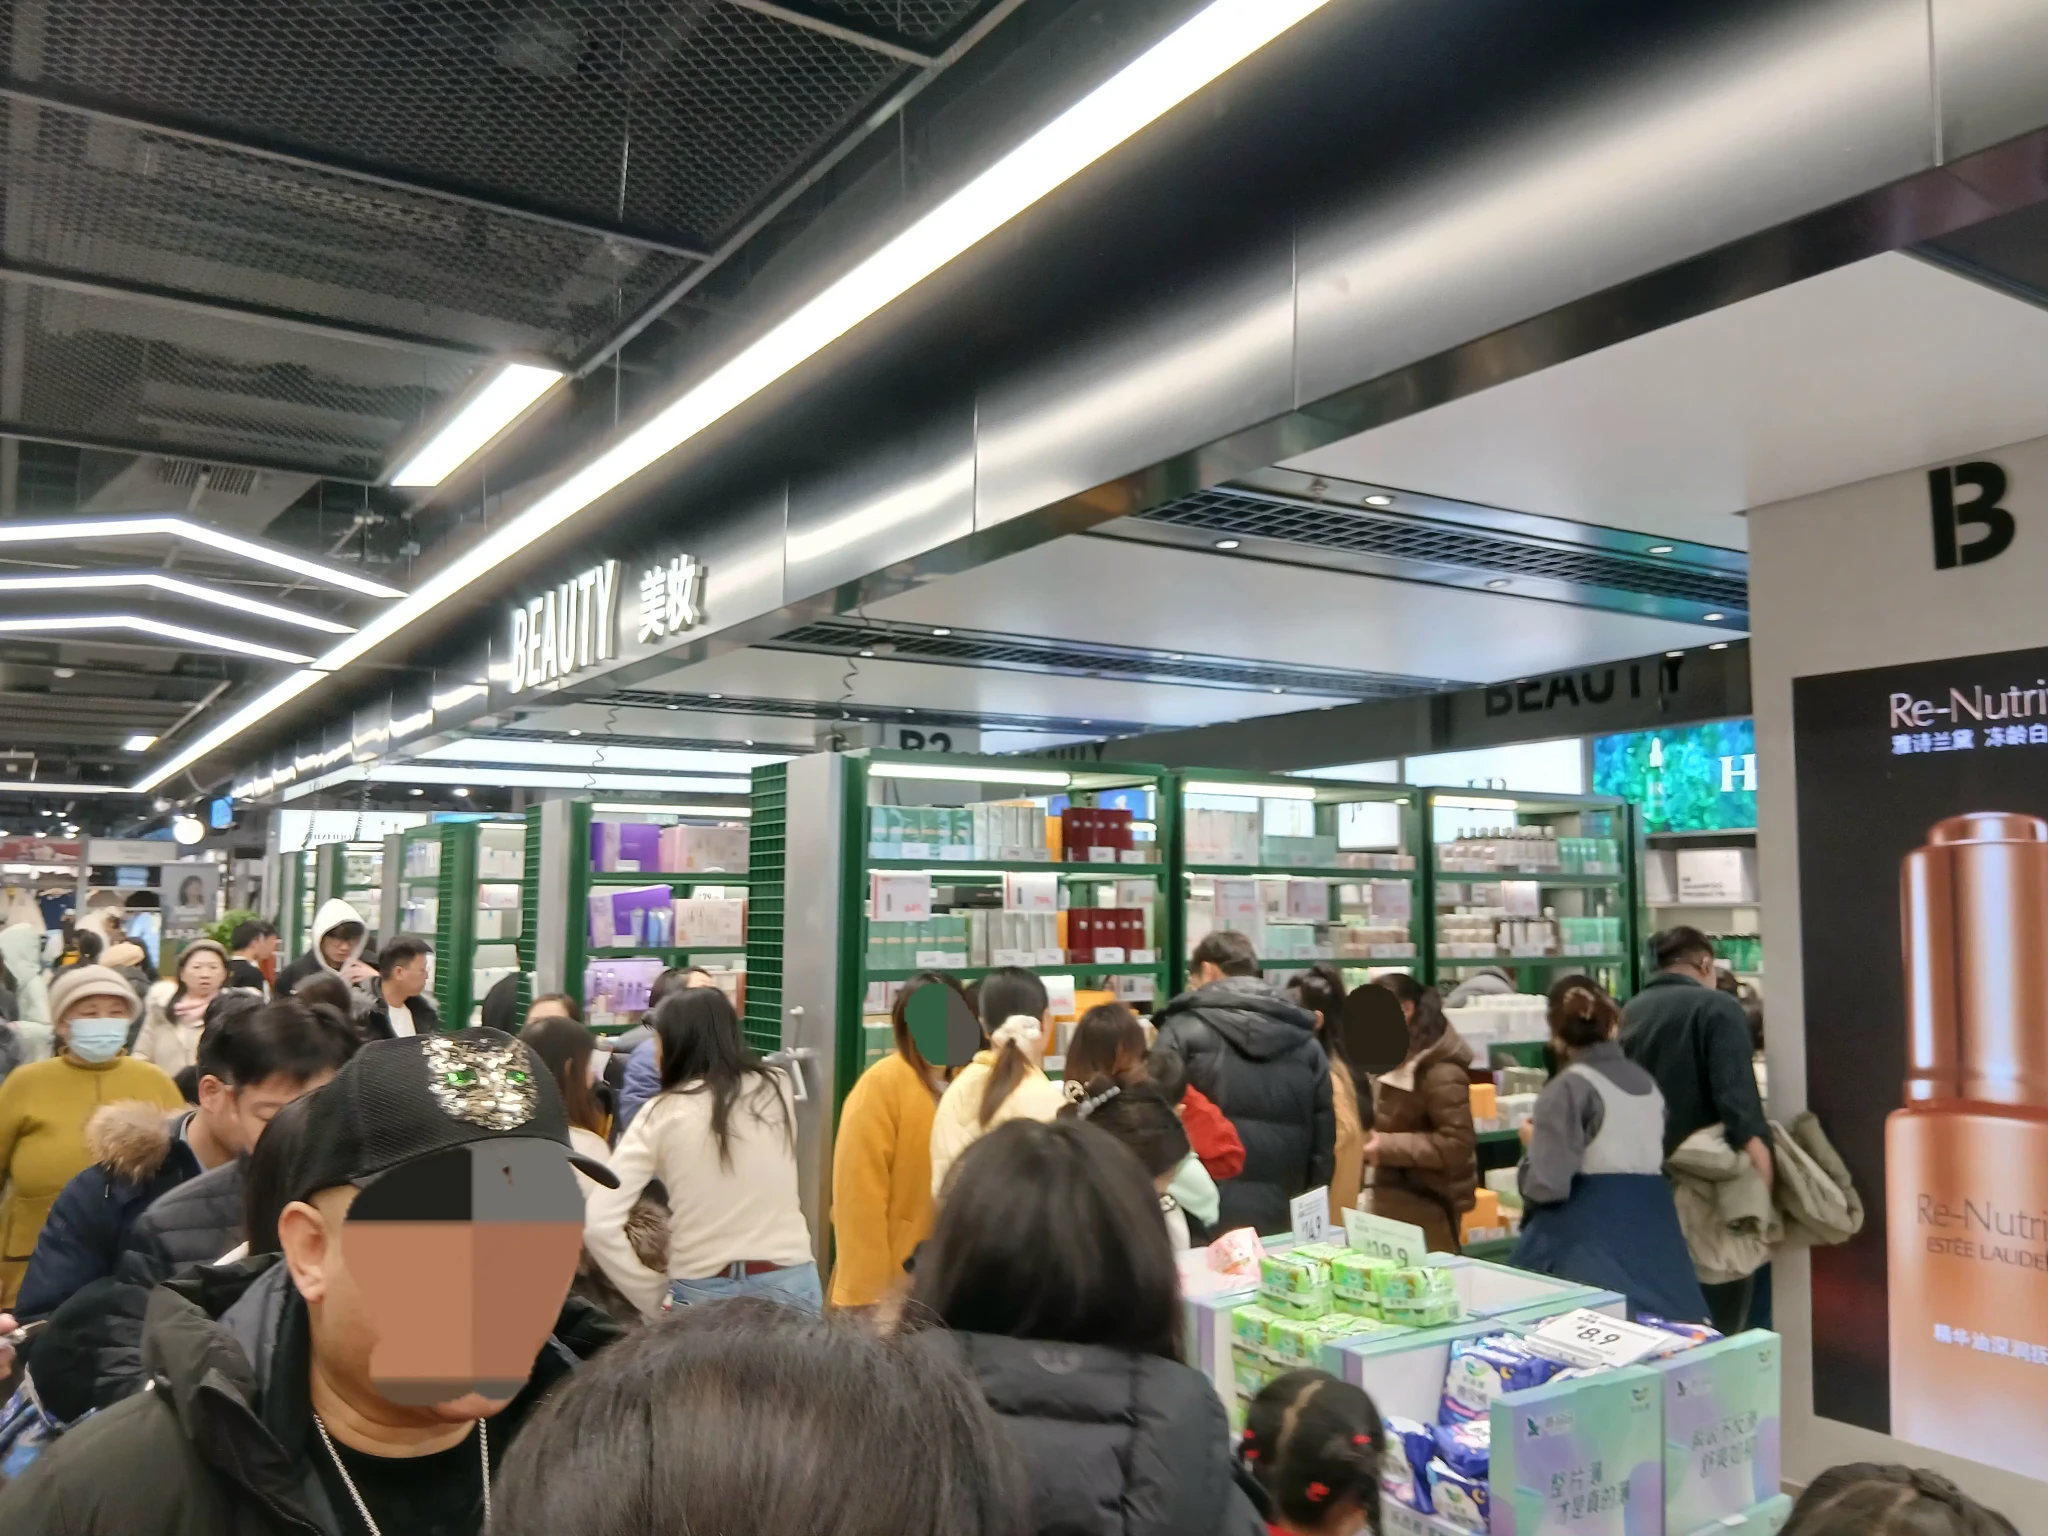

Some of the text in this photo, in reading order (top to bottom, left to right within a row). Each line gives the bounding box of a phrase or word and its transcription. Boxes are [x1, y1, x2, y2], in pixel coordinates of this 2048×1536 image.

[511, 554, 700, 694] BEAUTY 美妆
[1889, 678, 2048, 729] Re-Nutri
[1980, 1243, 2048, 1274] LAUDE
